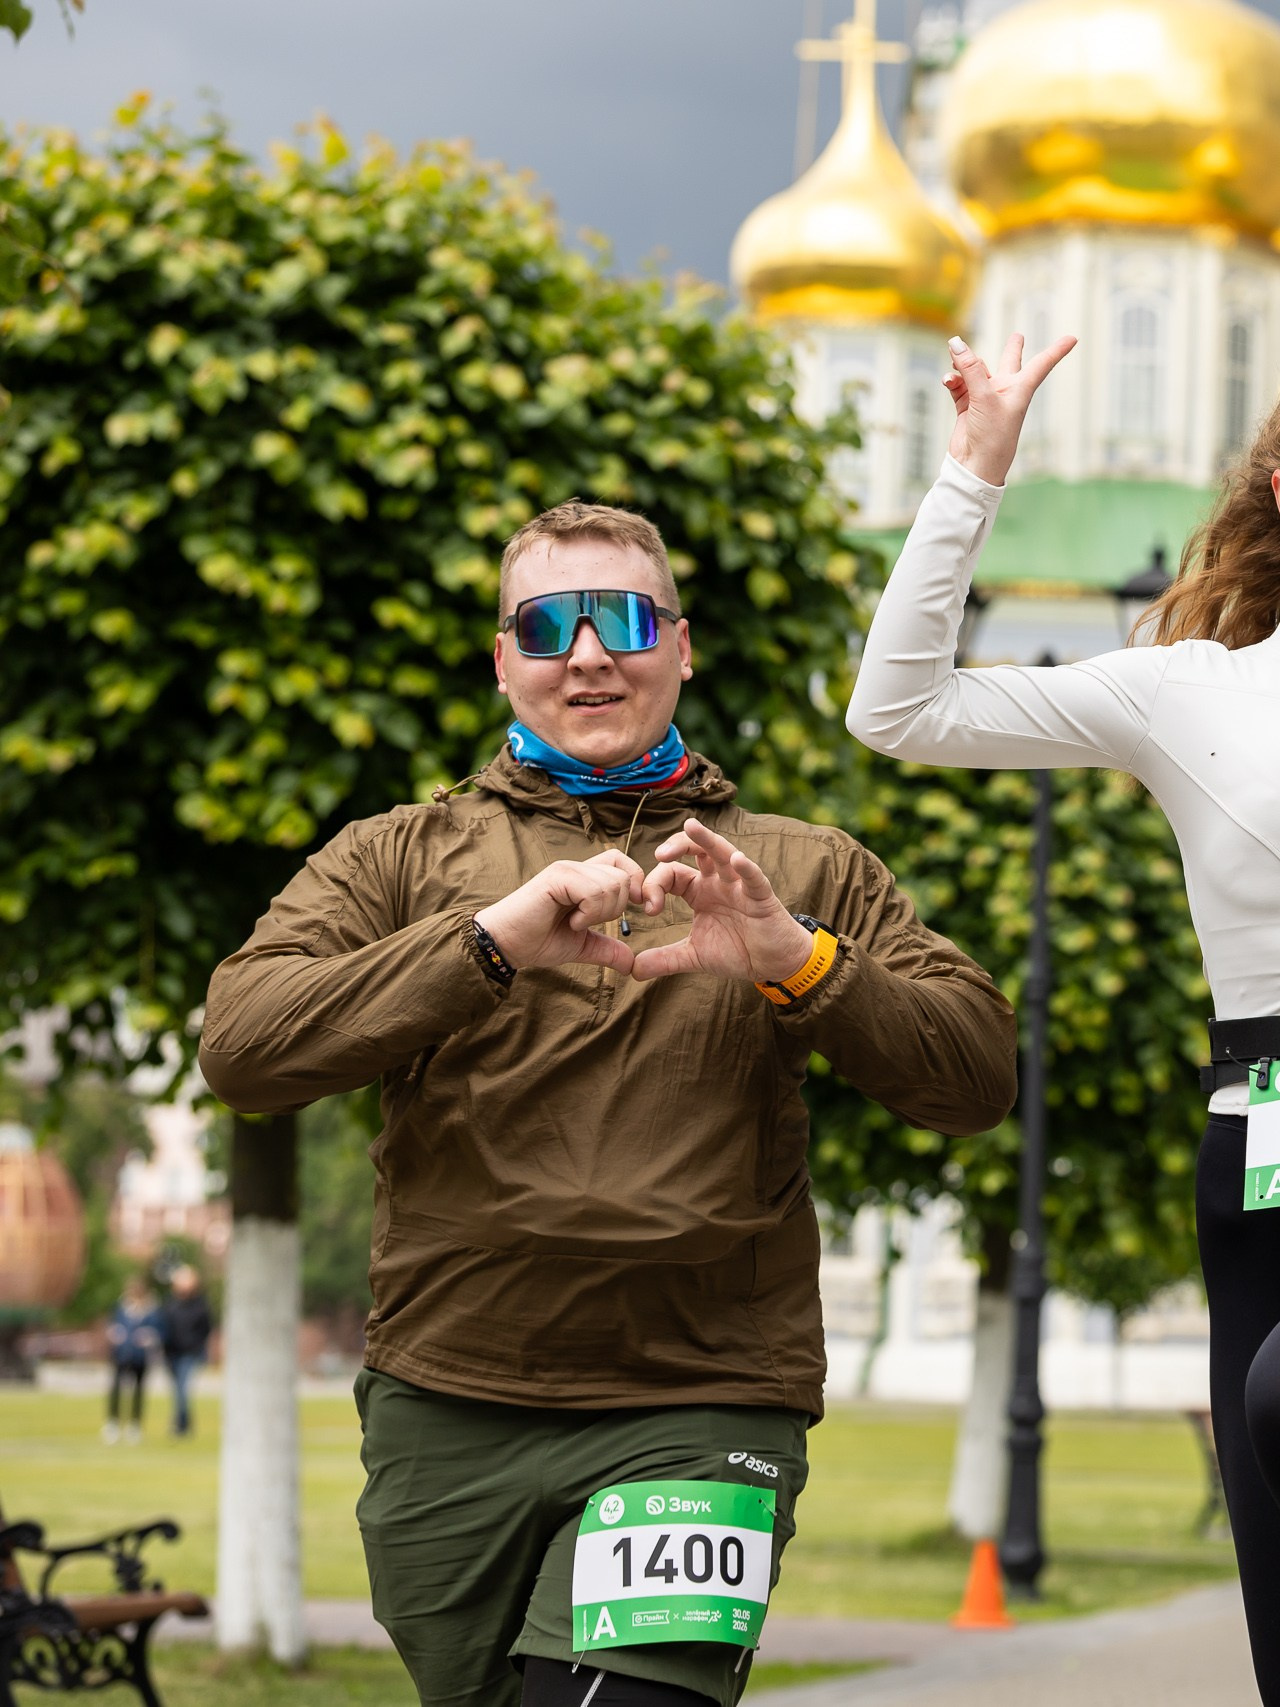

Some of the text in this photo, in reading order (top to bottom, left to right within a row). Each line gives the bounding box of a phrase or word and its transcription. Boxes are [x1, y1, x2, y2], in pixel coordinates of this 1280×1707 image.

[745, 1456, 779, 1478] asics
[668, 1497, 712, 1514] Звук
[613, 1533, 744, 1587] 1400
[732, 1608, 751, 1621] 30.05
[732, 1620, 748, 1632] 2026
